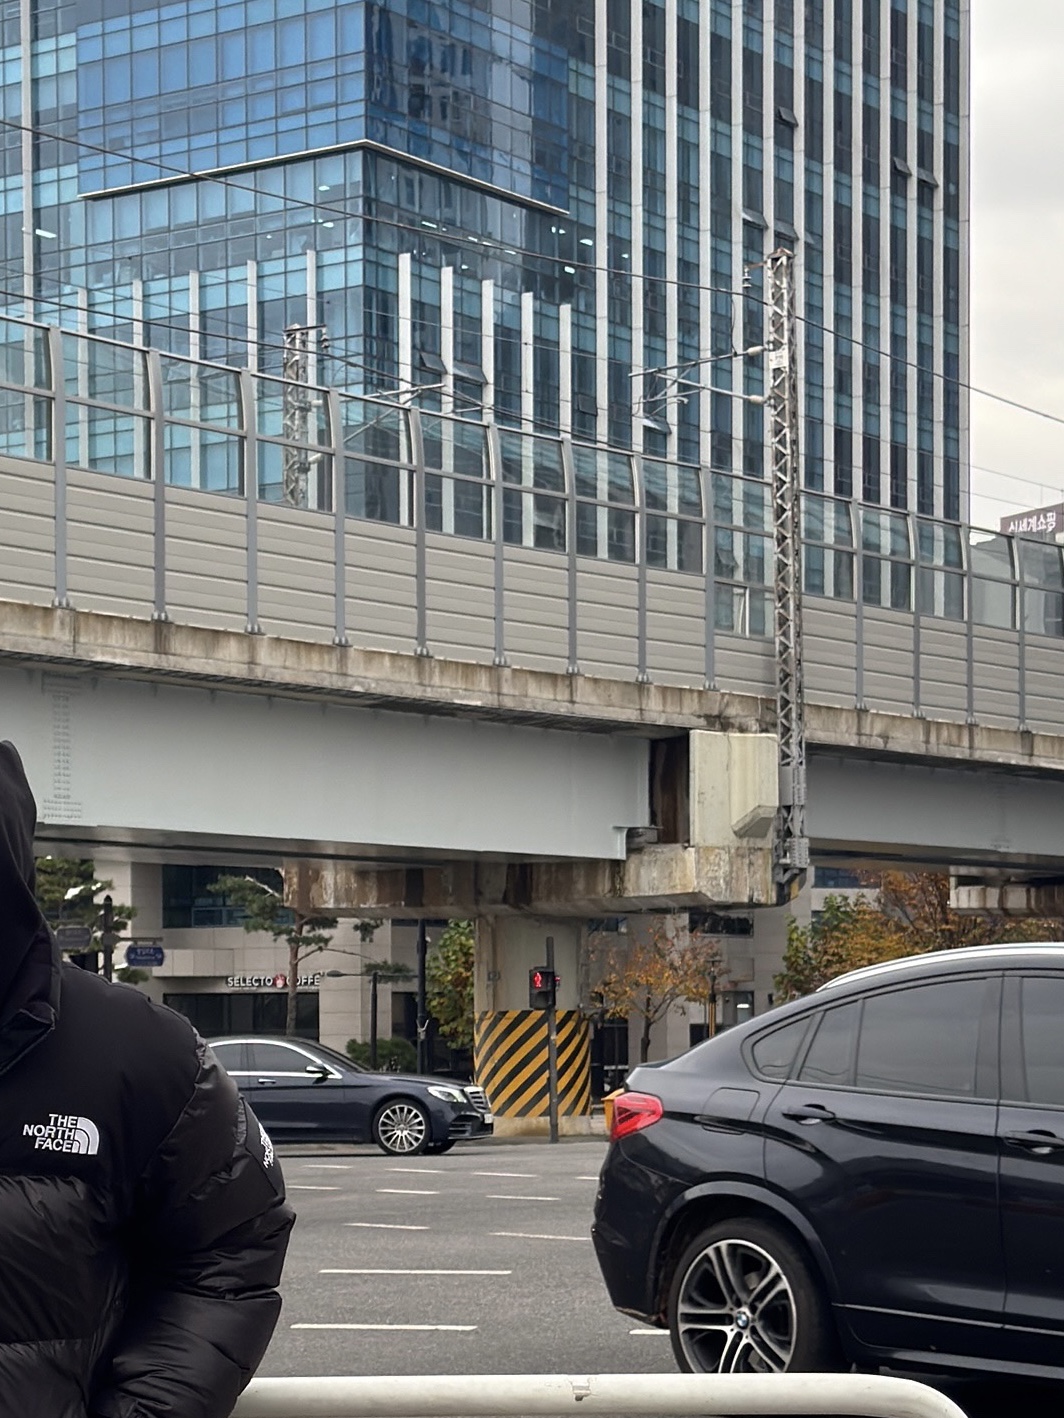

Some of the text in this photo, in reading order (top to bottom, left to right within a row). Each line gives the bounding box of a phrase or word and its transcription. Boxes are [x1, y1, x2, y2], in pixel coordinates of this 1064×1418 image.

[227, 976, 273, 987] SELECTO
[48, 1113, 78, 1128] THE
[22, 1123, 75, 1140] NORTH
[34, 1137, 73, 1153] FACE
